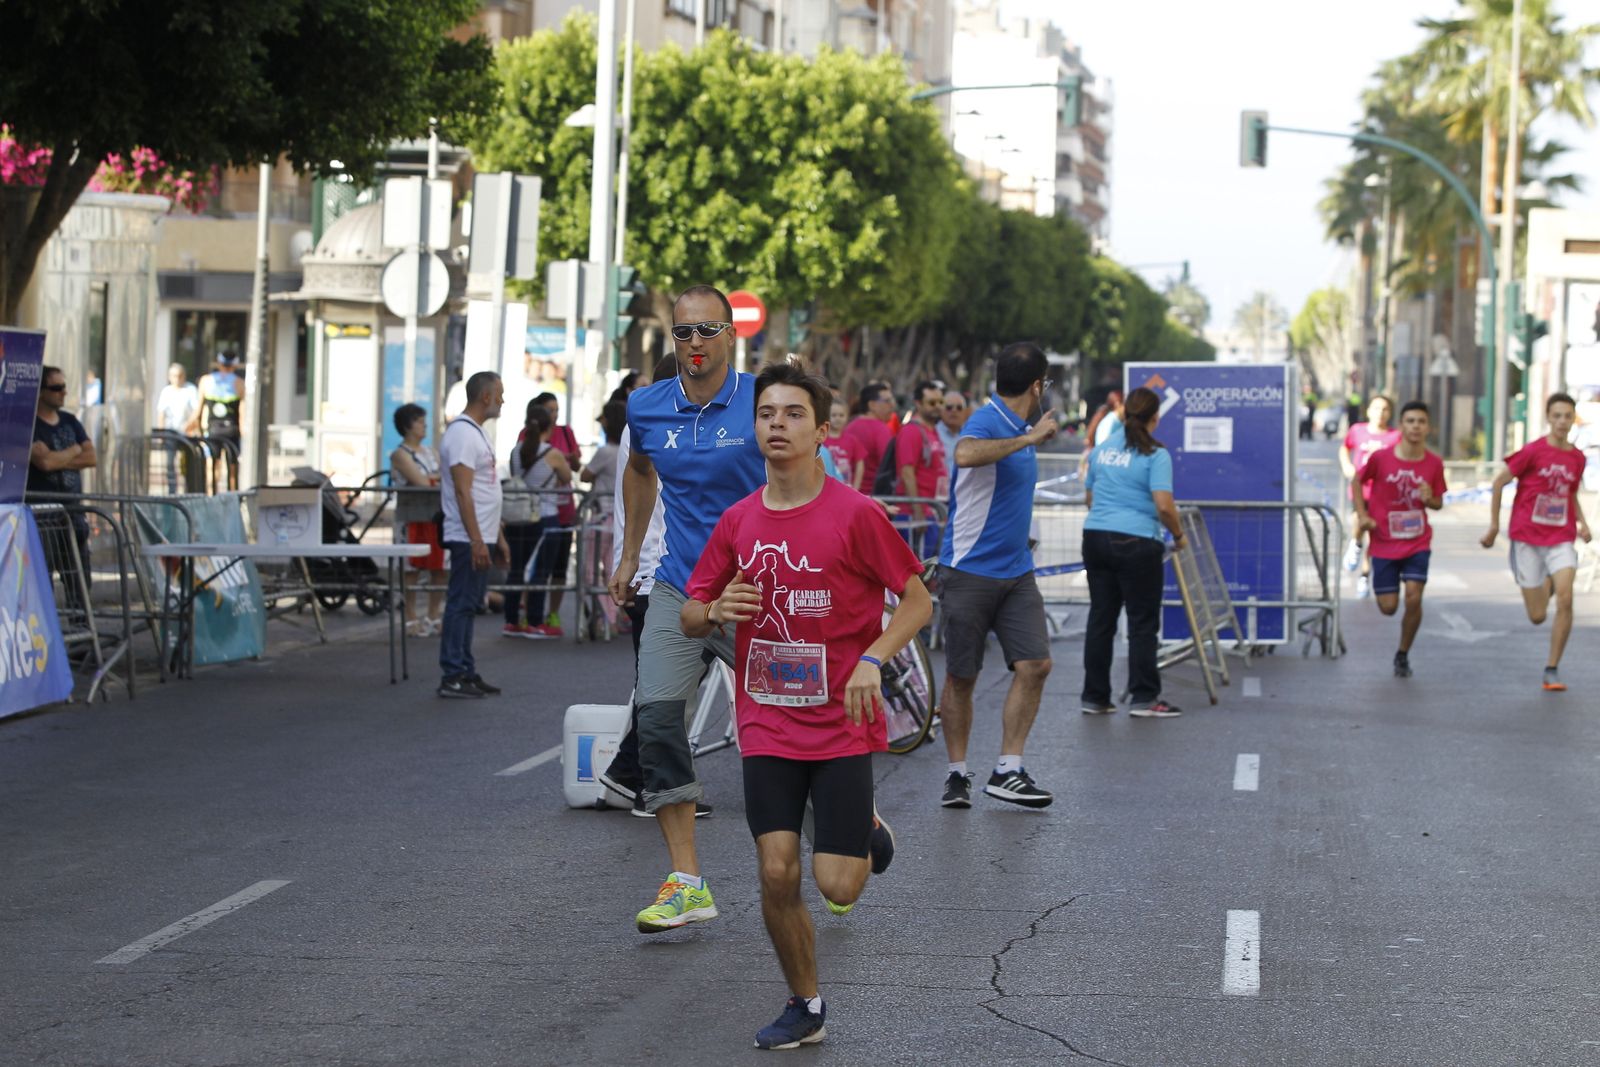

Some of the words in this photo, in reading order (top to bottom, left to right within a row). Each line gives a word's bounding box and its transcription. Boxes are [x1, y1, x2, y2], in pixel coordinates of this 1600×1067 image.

[1183, 386, 1283, 401] COOPERACIÓN
[1185, 400, 1217, 413] 2005
[784, 590, 797, 615] 4
[795, 590, 831, 599] CARRERA
[795, 598, 831, 607] SOLIDARIA
[0, 607, 48, 684] rtes
[768, 662, 818, 682] 1541
